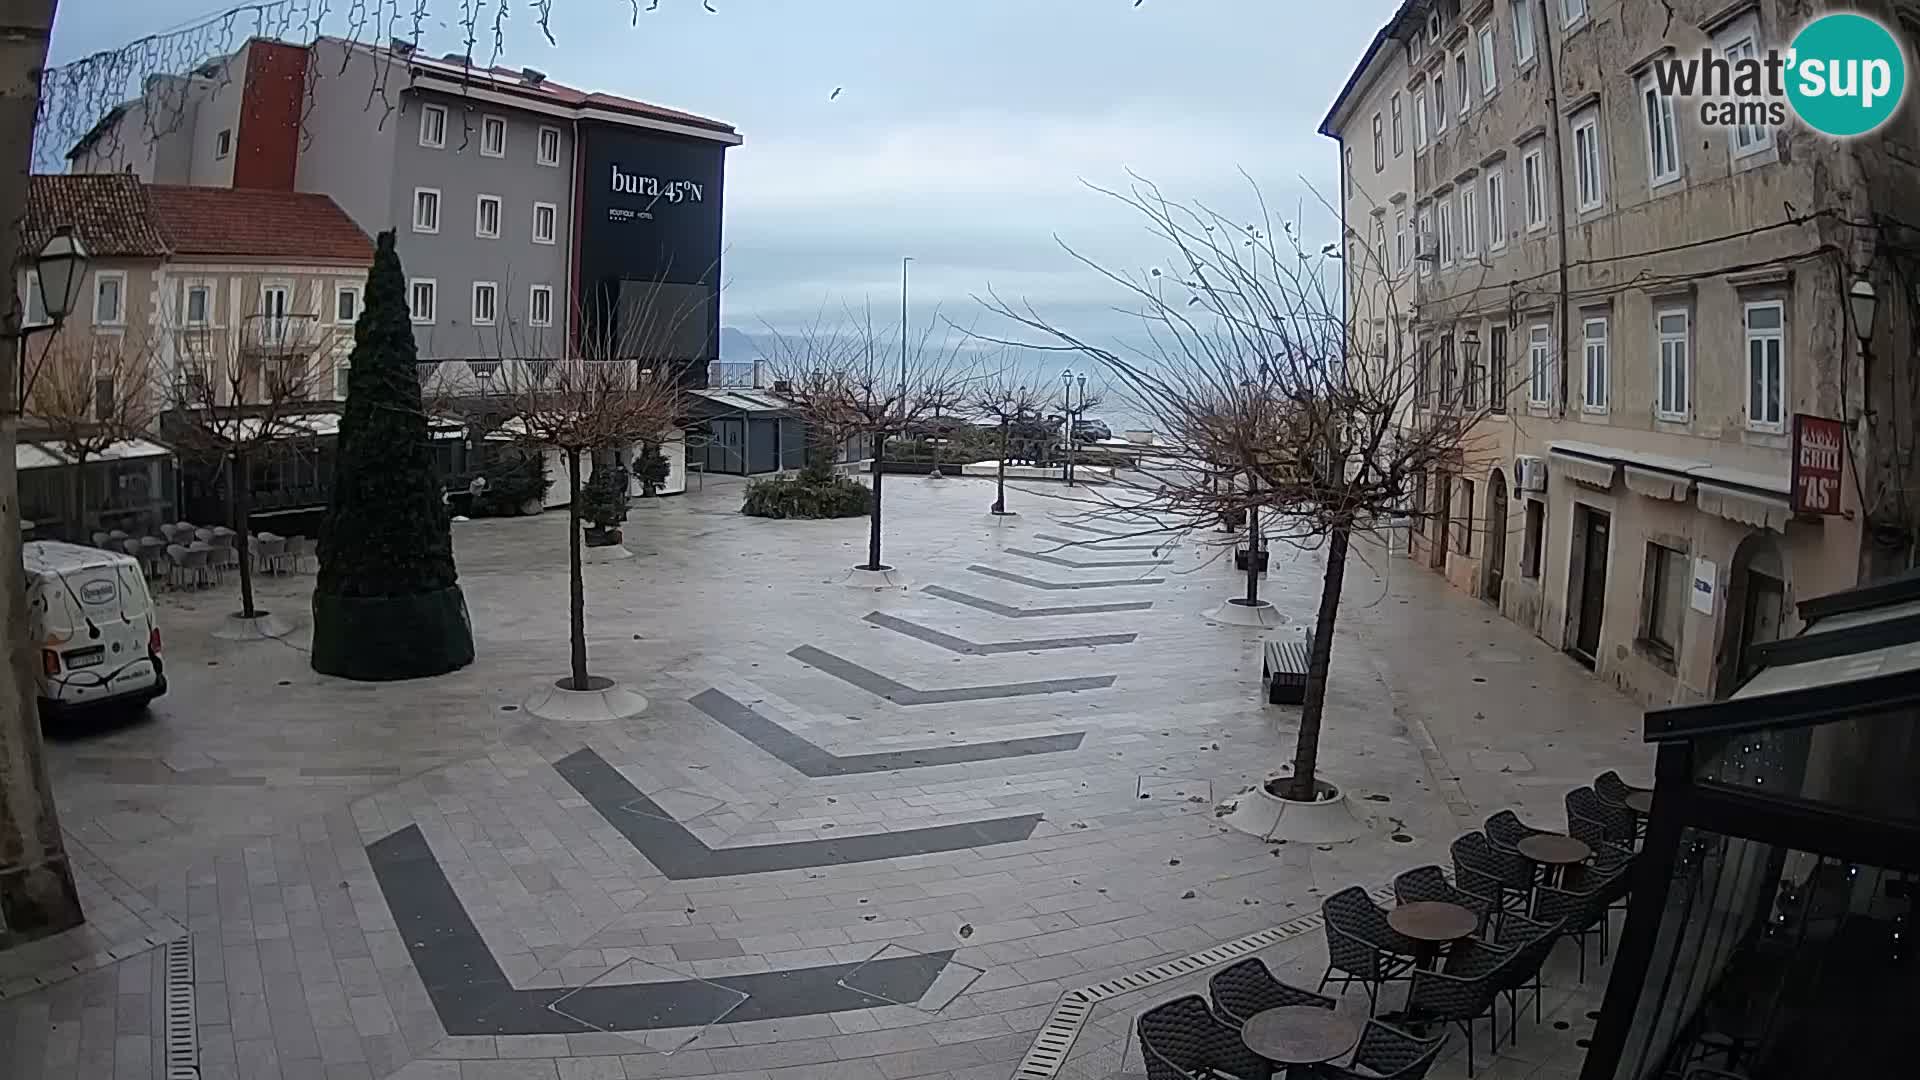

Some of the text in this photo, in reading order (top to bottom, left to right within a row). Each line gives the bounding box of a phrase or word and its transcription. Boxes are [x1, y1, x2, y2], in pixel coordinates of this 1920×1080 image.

[612, 165, 658, 196] bura
[609, 208, 653, 220] BOUTIQUE HOTEL
[1800, 447, 1840, 472] GRILL
[1799, 475, 1838, 509] "AS"
